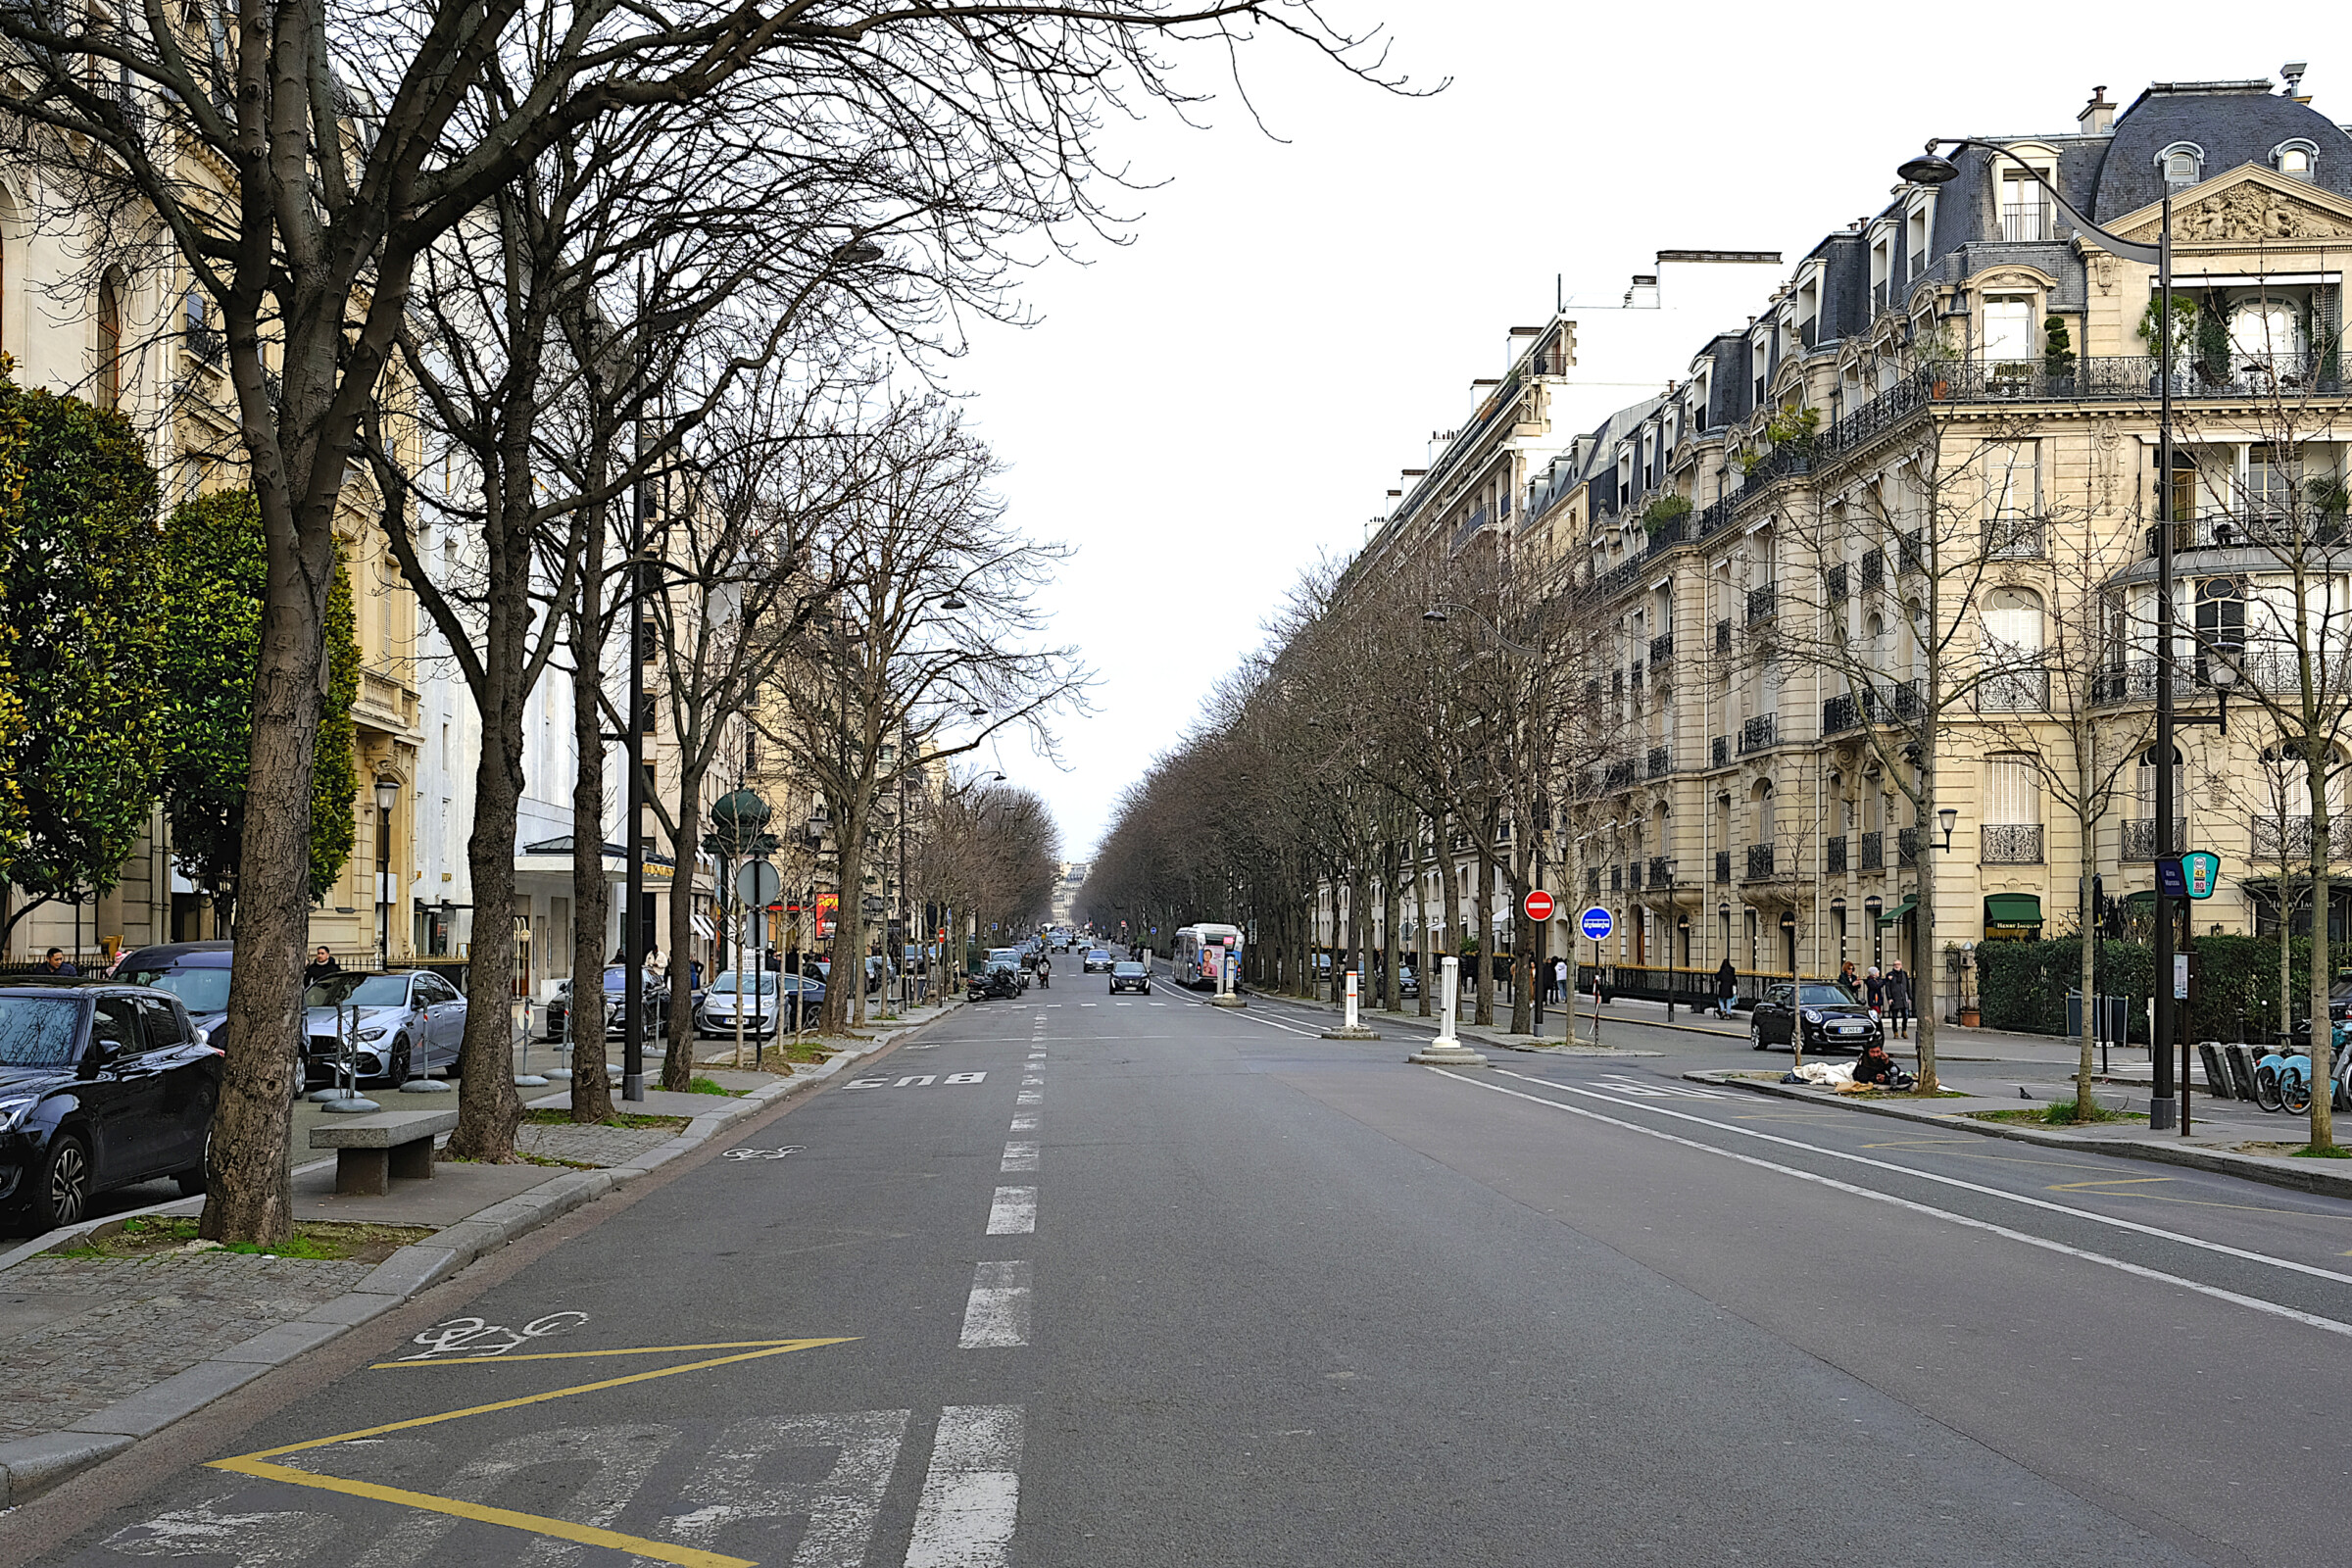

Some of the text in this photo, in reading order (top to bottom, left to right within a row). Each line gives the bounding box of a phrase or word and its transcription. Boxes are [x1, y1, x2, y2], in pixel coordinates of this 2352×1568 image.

[2269, 900, 2296, 908] HERY
[842, 1071, 988, 1090] BUS
[1585, 1081, 1782, 1103] BUS
